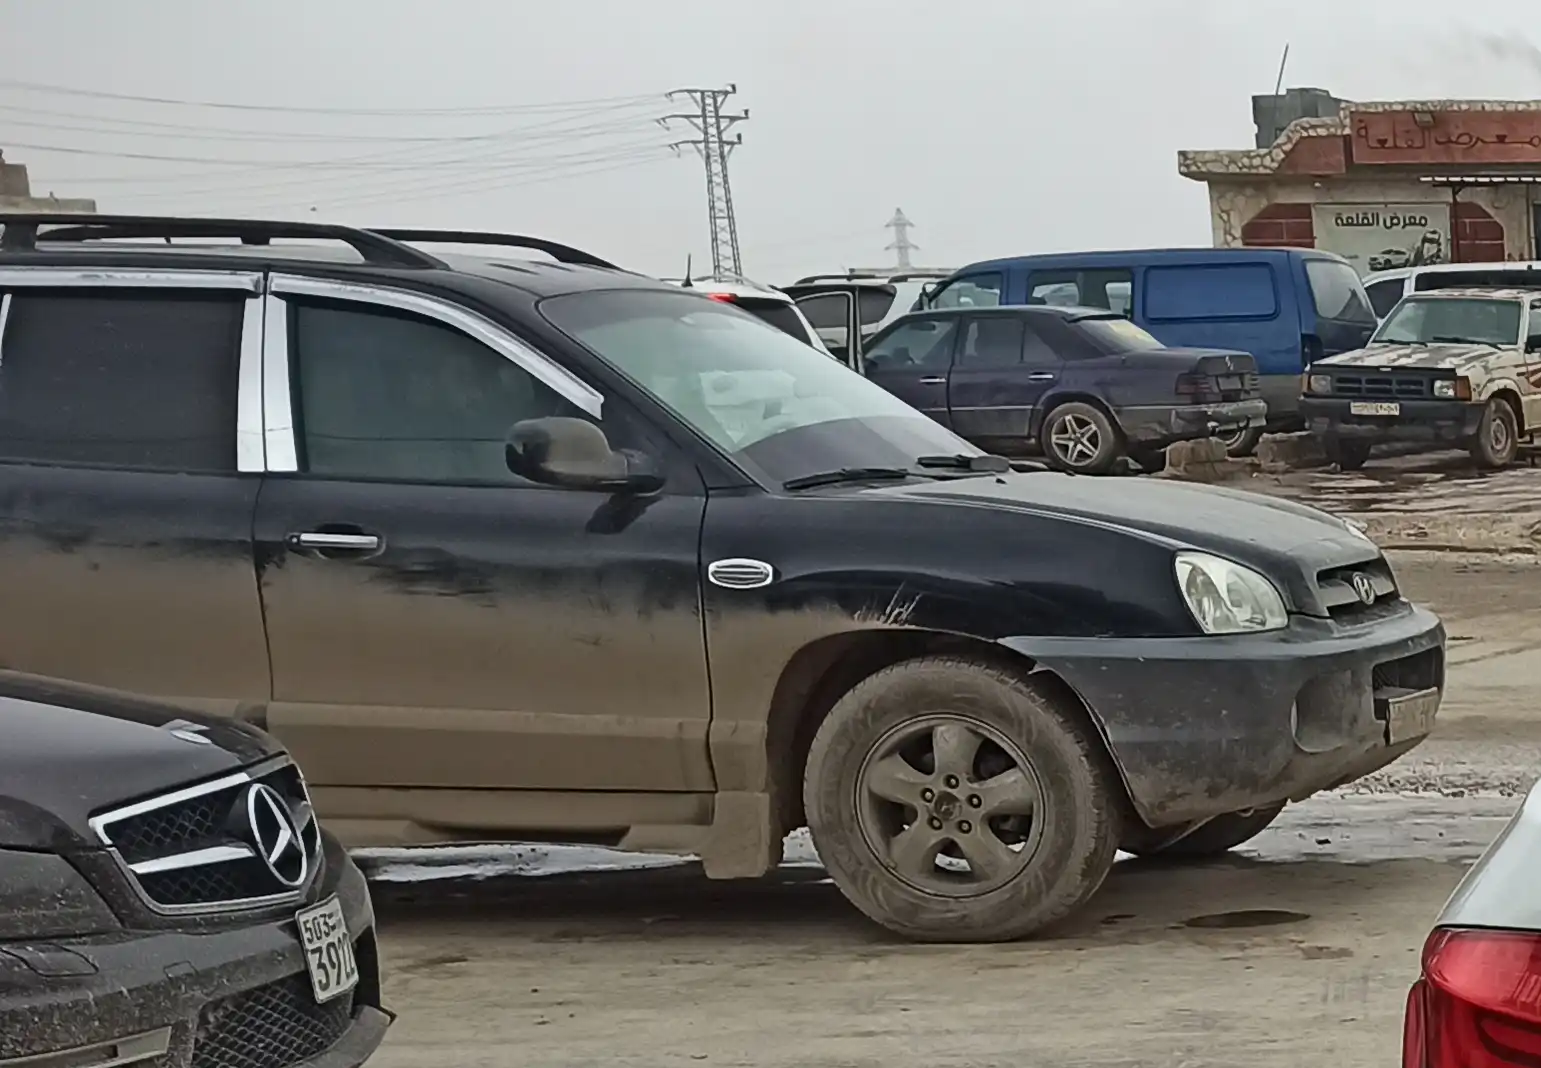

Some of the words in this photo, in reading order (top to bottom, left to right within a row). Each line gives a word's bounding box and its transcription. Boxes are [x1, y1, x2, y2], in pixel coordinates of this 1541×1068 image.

[1356, 118, 1431, 150] القلعة
[1435, 125, 1541, 150] معرض
[1334, 211, 1380, 227] القلعة
[1382, 212, 1428, 230] معرض
[302, 912, 331, 944] 503
